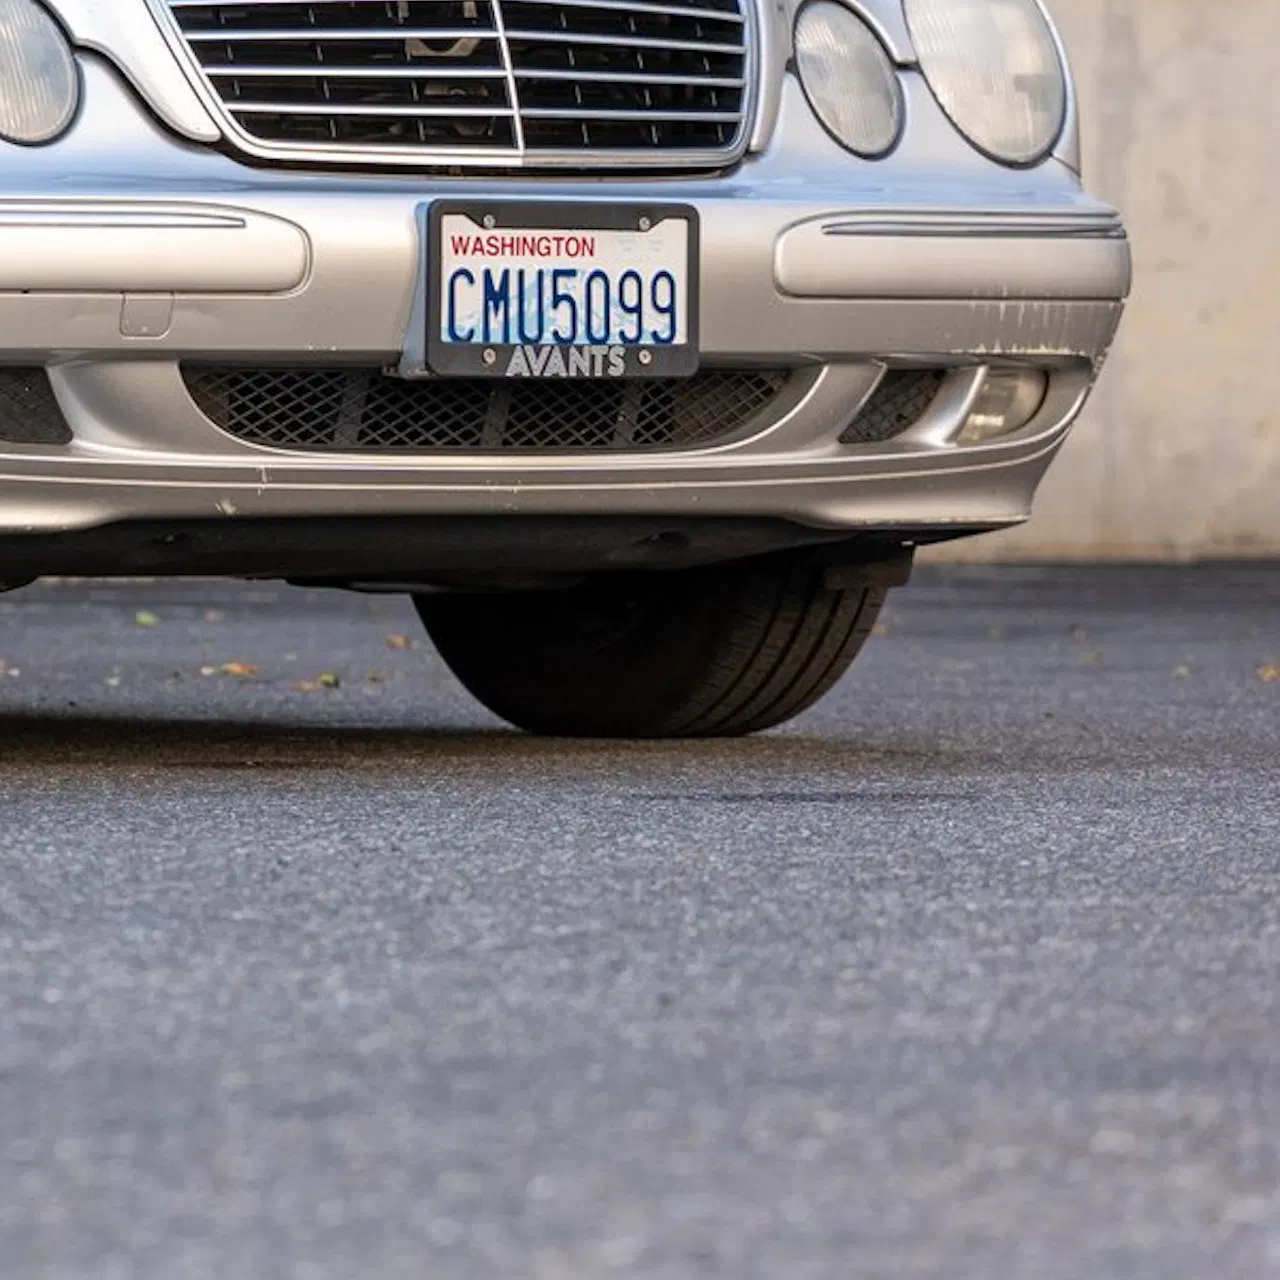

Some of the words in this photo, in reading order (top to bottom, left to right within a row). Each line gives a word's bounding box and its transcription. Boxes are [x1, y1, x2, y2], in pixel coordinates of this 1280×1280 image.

[451, 236, 594, 257] WASHINGTON
[448, 267, 676, 343] CMU5099
[505, 344, 625, 377] AVANTS
